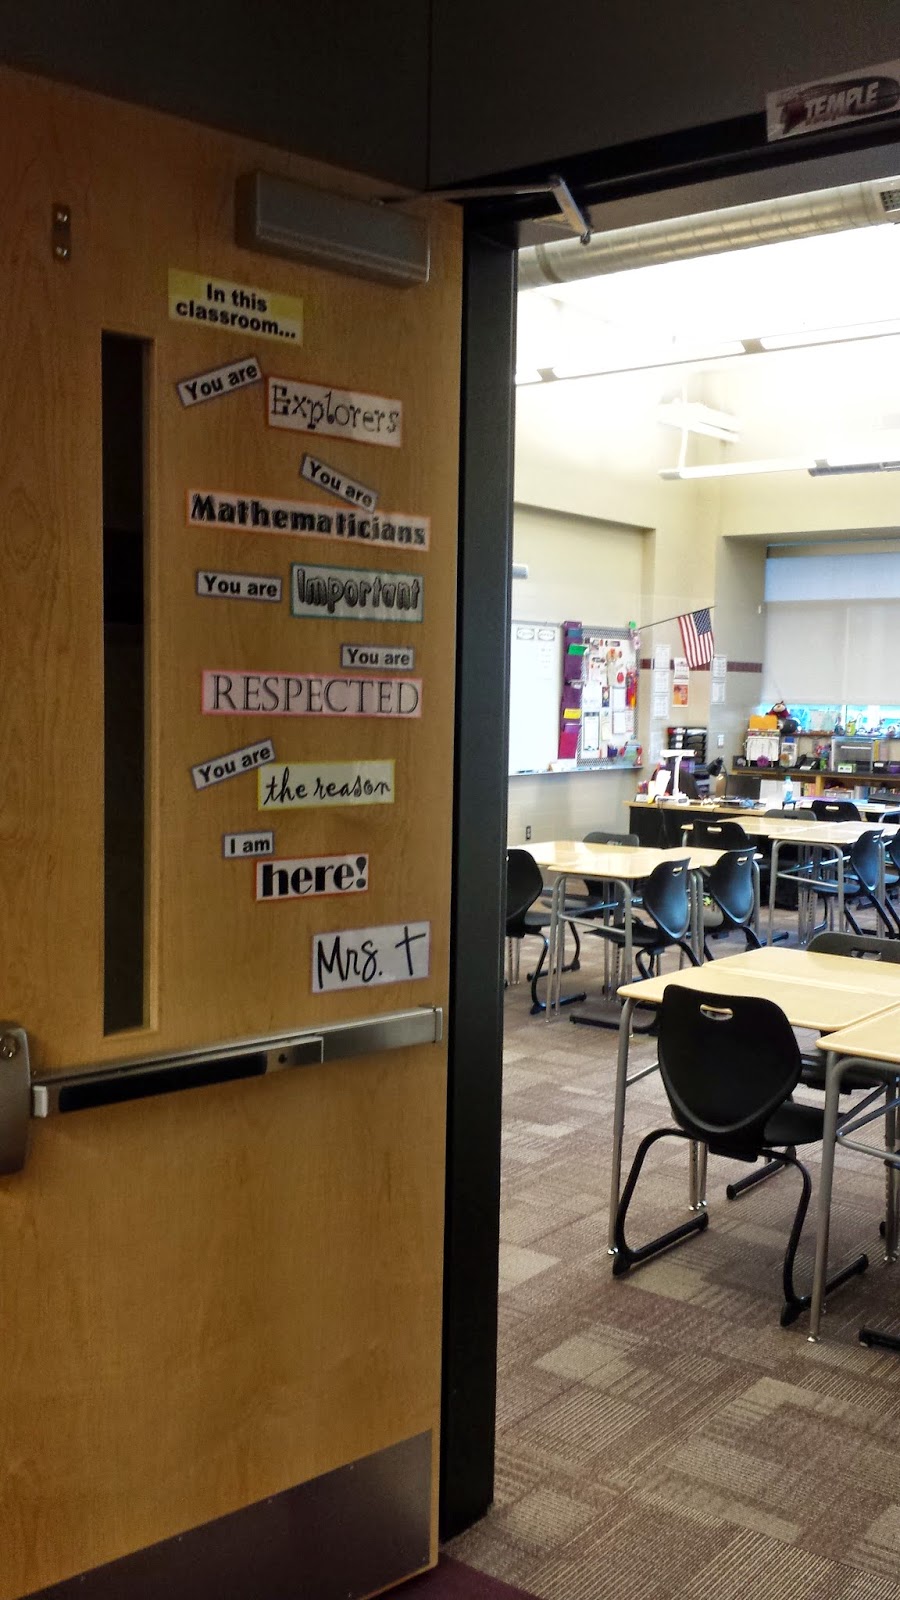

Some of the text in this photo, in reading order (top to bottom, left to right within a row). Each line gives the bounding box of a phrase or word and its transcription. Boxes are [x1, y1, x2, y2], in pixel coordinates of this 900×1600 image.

[804, 81, 879, 121] TEMPLE
[206, 283, 268, 313] In this
[175, 299, 296, 339] classroom...
[185, 363, 258, 400] You are
[271, 384, 400, 434] Explorers
[309, 461, 373, 508] You are
[190, 493, 426, 545] Mathematicians
[204, 575, 278, 597] You are
[296, 568, 421, 613] Important
[347, 649, 410, 666] You are
[211, 674, 419, 714] RESPECTED
[198, 746, 271, 783] You are
[263, 766, 391, 806] the reason
[230, 836, 270, 855] I am
[262, 856, 367, 898] here!
[317, 935, 383, 989] Mrs.
